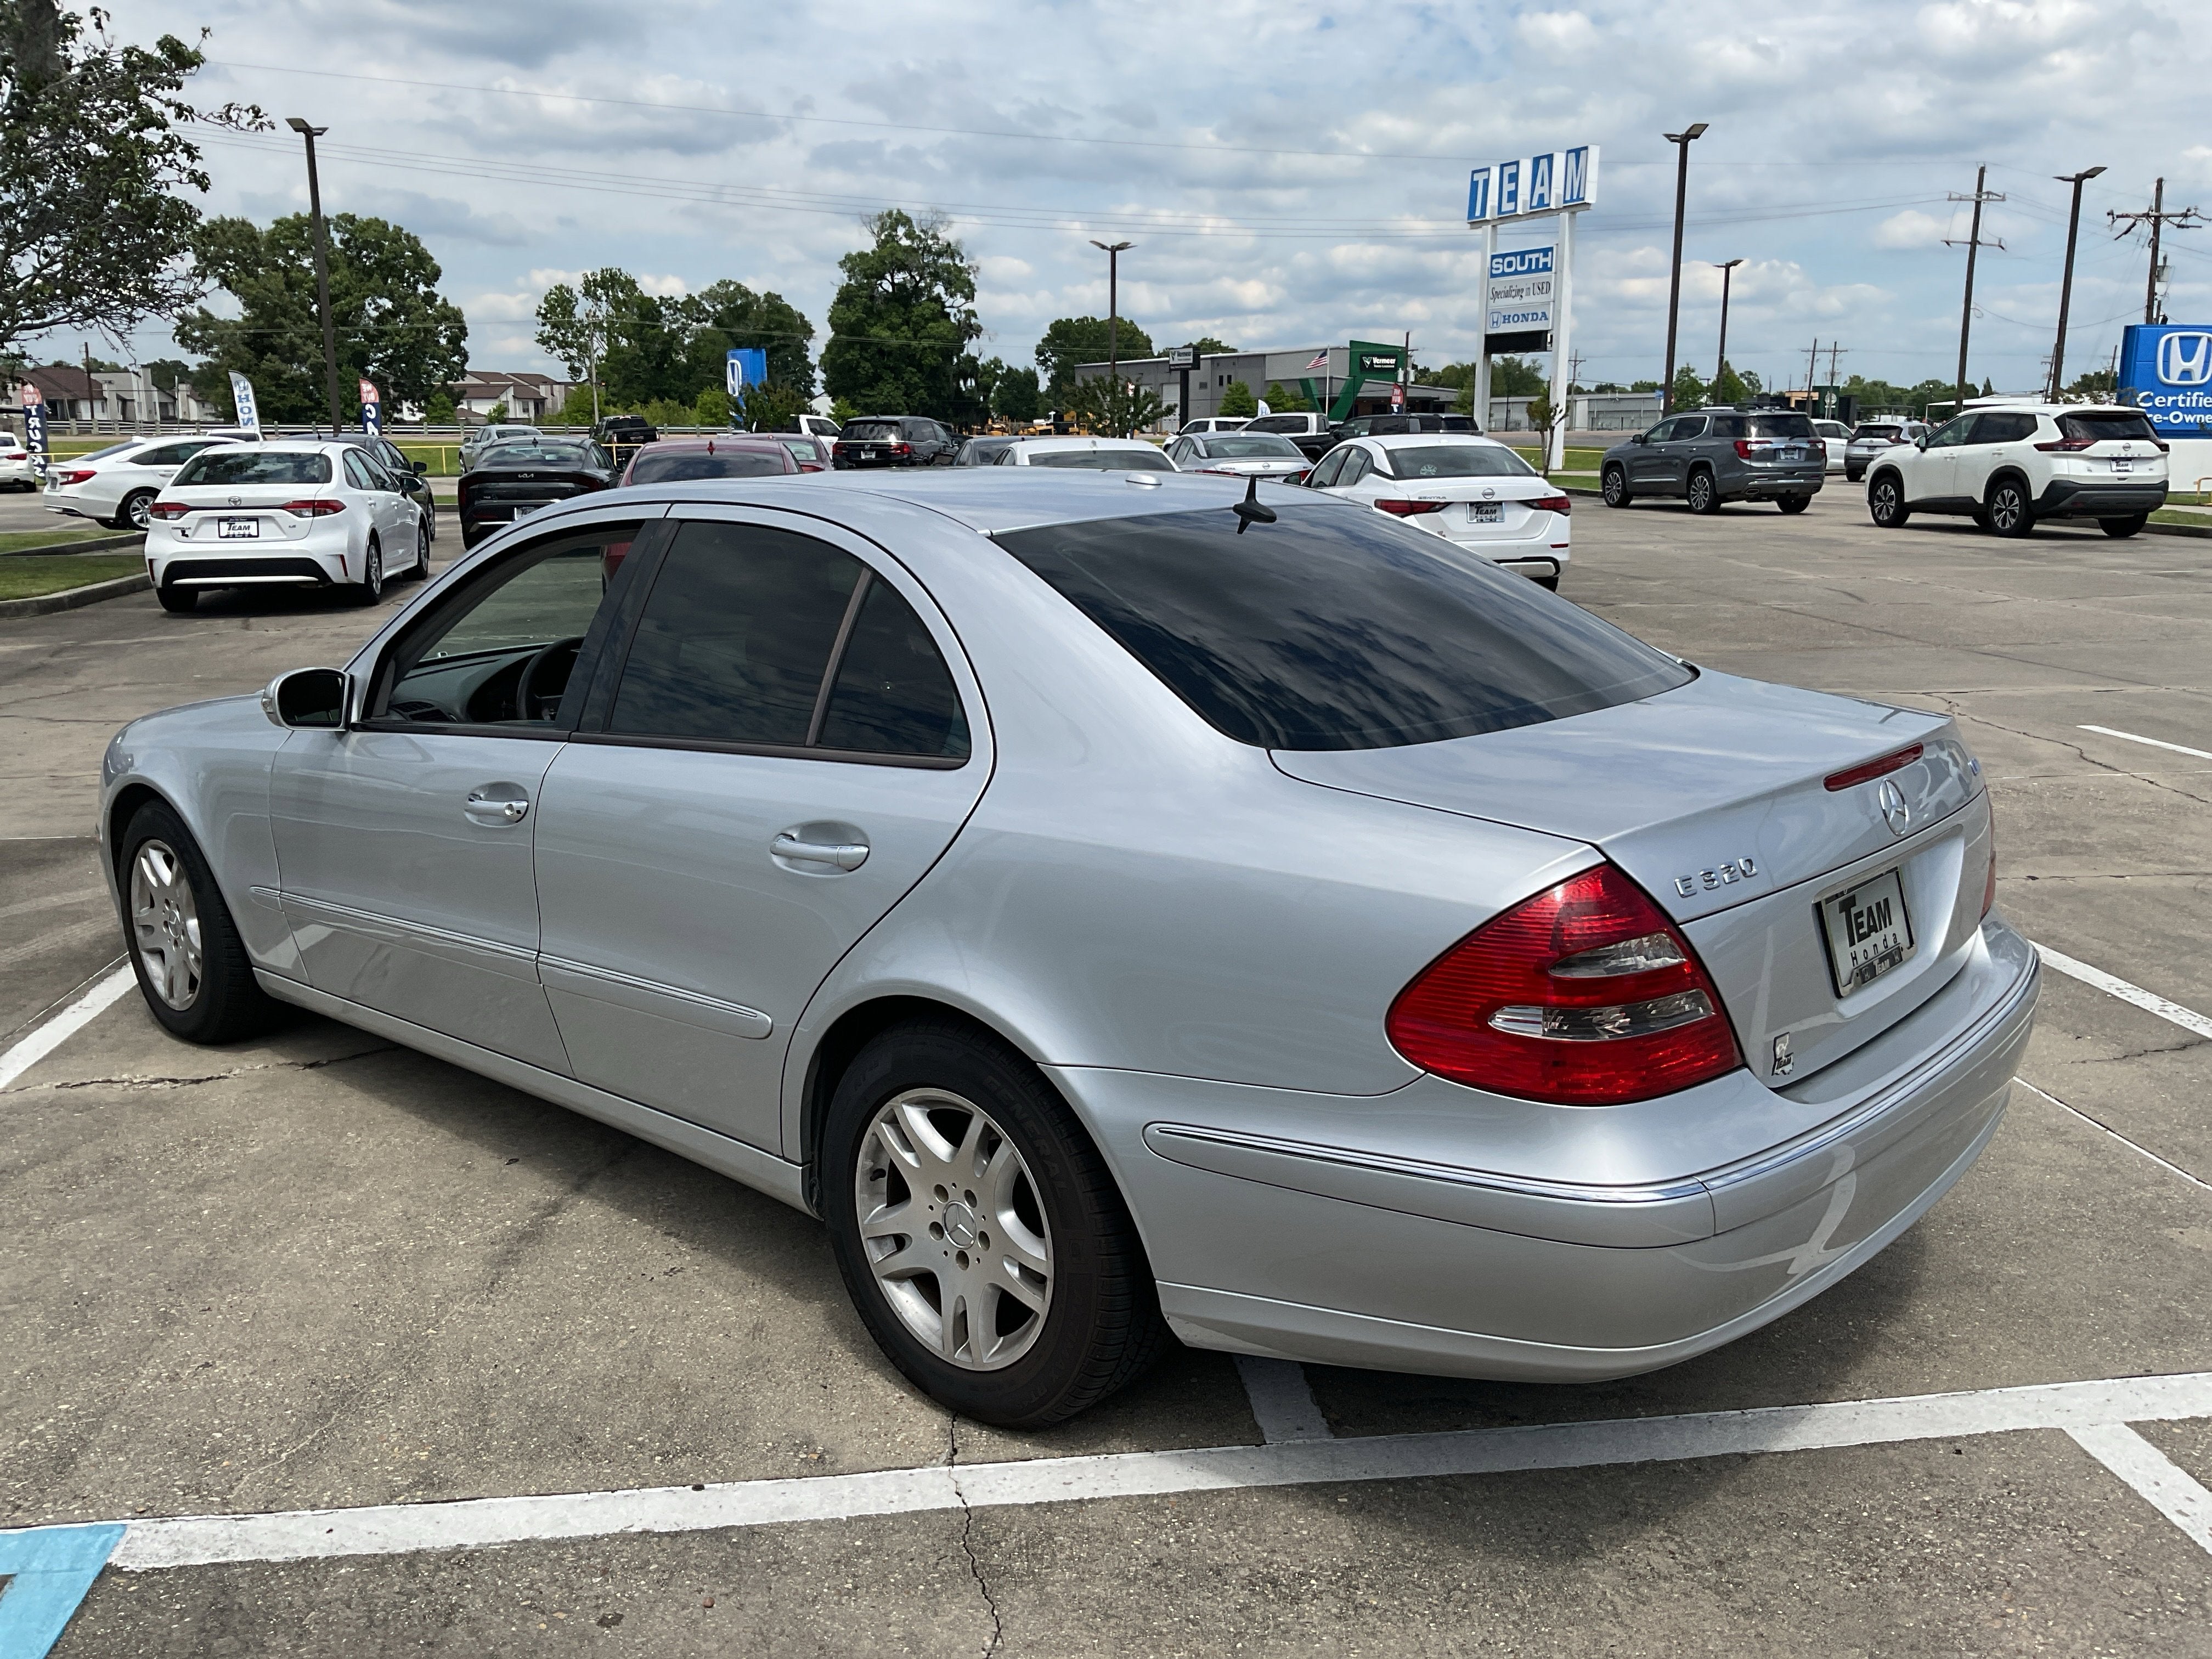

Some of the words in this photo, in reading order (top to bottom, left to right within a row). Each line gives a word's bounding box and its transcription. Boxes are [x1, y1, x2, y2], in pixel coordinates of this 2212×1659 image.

[1471, 149, 1588, 217] TEAM
[1491, 251, 1552, 274] SOUTH
[1490, 285, 1524, 303] Specializing
[1525, 284, 1531, 296] in
[1532, 281, 1550, 296] USED
[1502, 311, 1549, 324] HONDA
[2136, 391, 2212, 408] Certifie
[1475, 505, 1497, 515] TEAM
[227, 522, 250, 531] TEAM
[1674, 874, 1697, 898] E
[1699, 855, 1758, 890] 320
[1838, 894, 1892, 948] TEAM
[1850, 932, 1898, 967] Honda
[1873, 958, 1891, 976] TEAM
